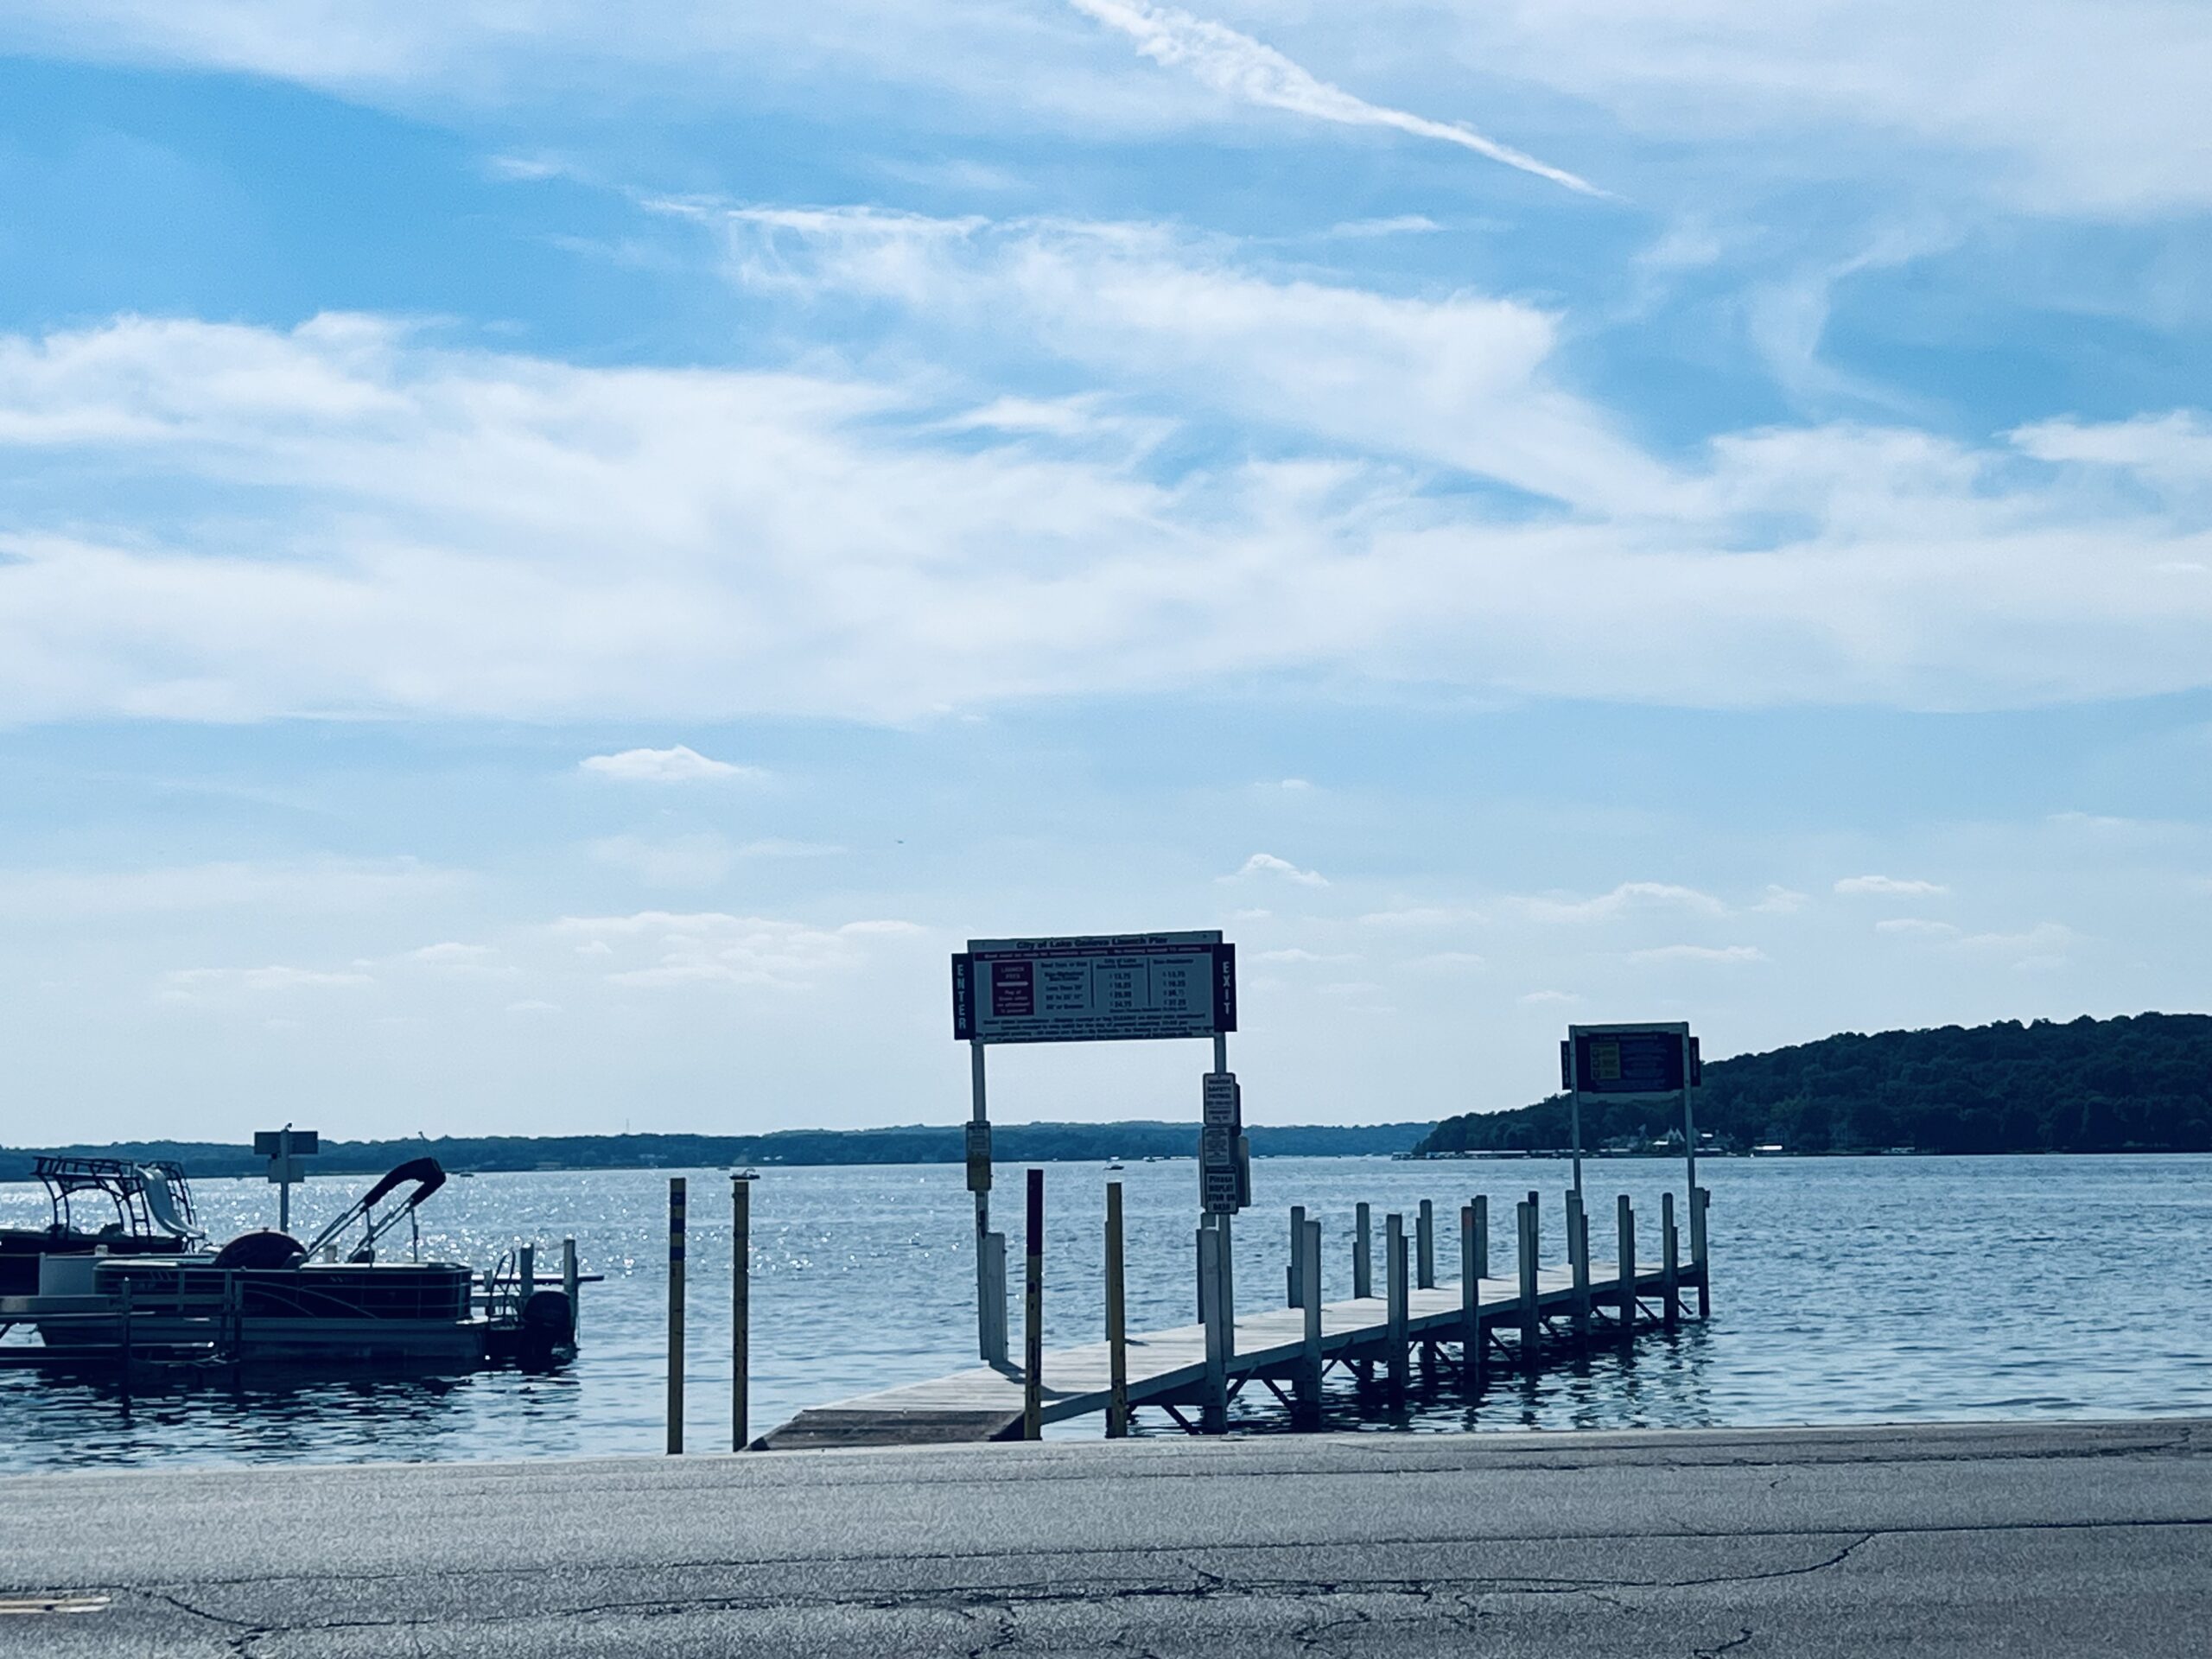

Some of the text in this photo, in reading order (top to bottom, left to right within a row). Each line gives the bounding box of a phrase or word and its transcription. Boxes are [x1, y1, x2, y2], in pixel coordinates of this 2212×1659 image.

[1016, 941, 1035, 950] City
[1037, 940, 1047, 949] of
[1049, 938, 1072, 948] Lake
[957, 964, 967, 1029] ENTER
[1223, 961, 1231, 1014] EXIT
